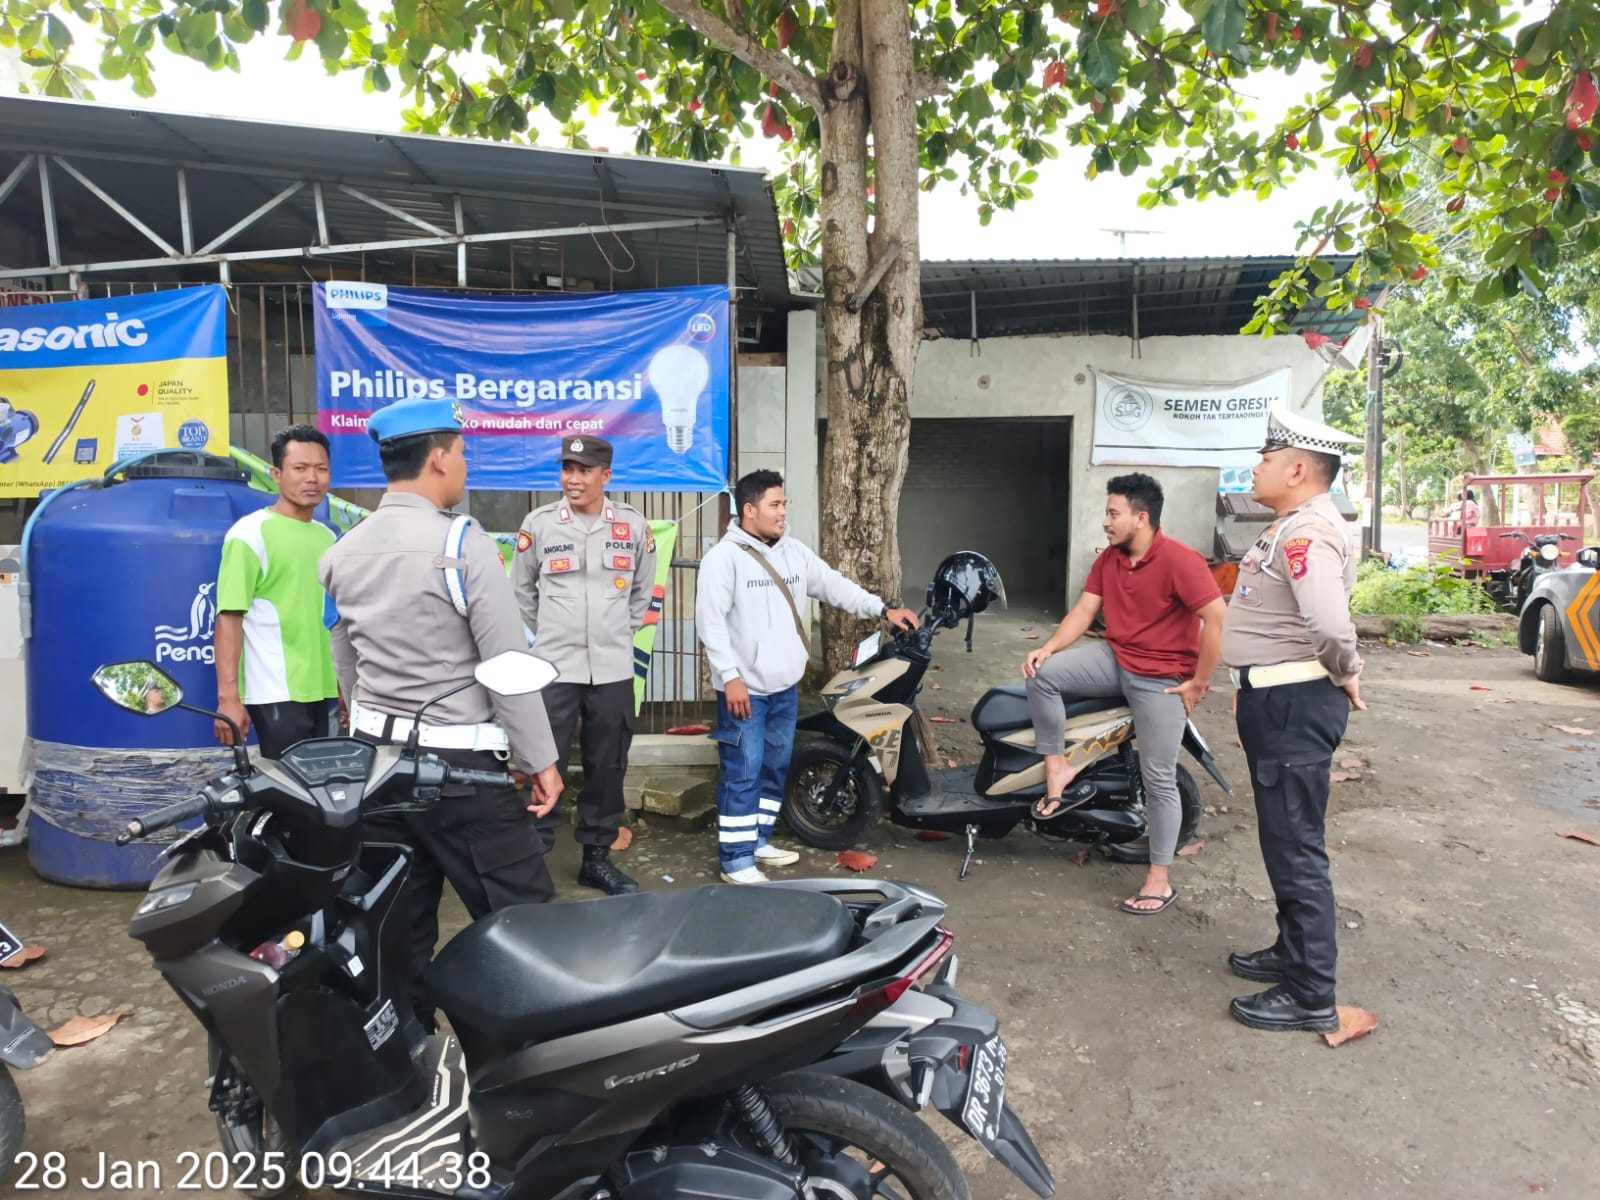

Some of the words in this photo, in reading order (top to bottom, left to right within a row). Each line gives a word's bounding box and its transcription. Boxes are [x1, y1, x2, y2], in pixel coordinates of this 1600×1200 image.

[330, 289, 382, 301] PHILIPS
[692, 323, 712, 333] LED
[158, 380, 184, 388] JAPAN
[330, 369, 446, 399] Philips
[455, 373, 642, 407] Bergaransi
[158, 387, 193, 395] QUALITY
[1163, 399, 1221, 412] SEMEN
[482, 417, 532, 430] mudah
[535, 417, 562, 430] dan
[566, 417, 605, 432] cepat
[182, 426, 205, 436] TOP
[605, 542, 634, 550] POLRI
[202, 976, 248, 996] HONDA
[974, 1049, 994, 1104] 3673
[967, 1096, 989, 1134] DR
